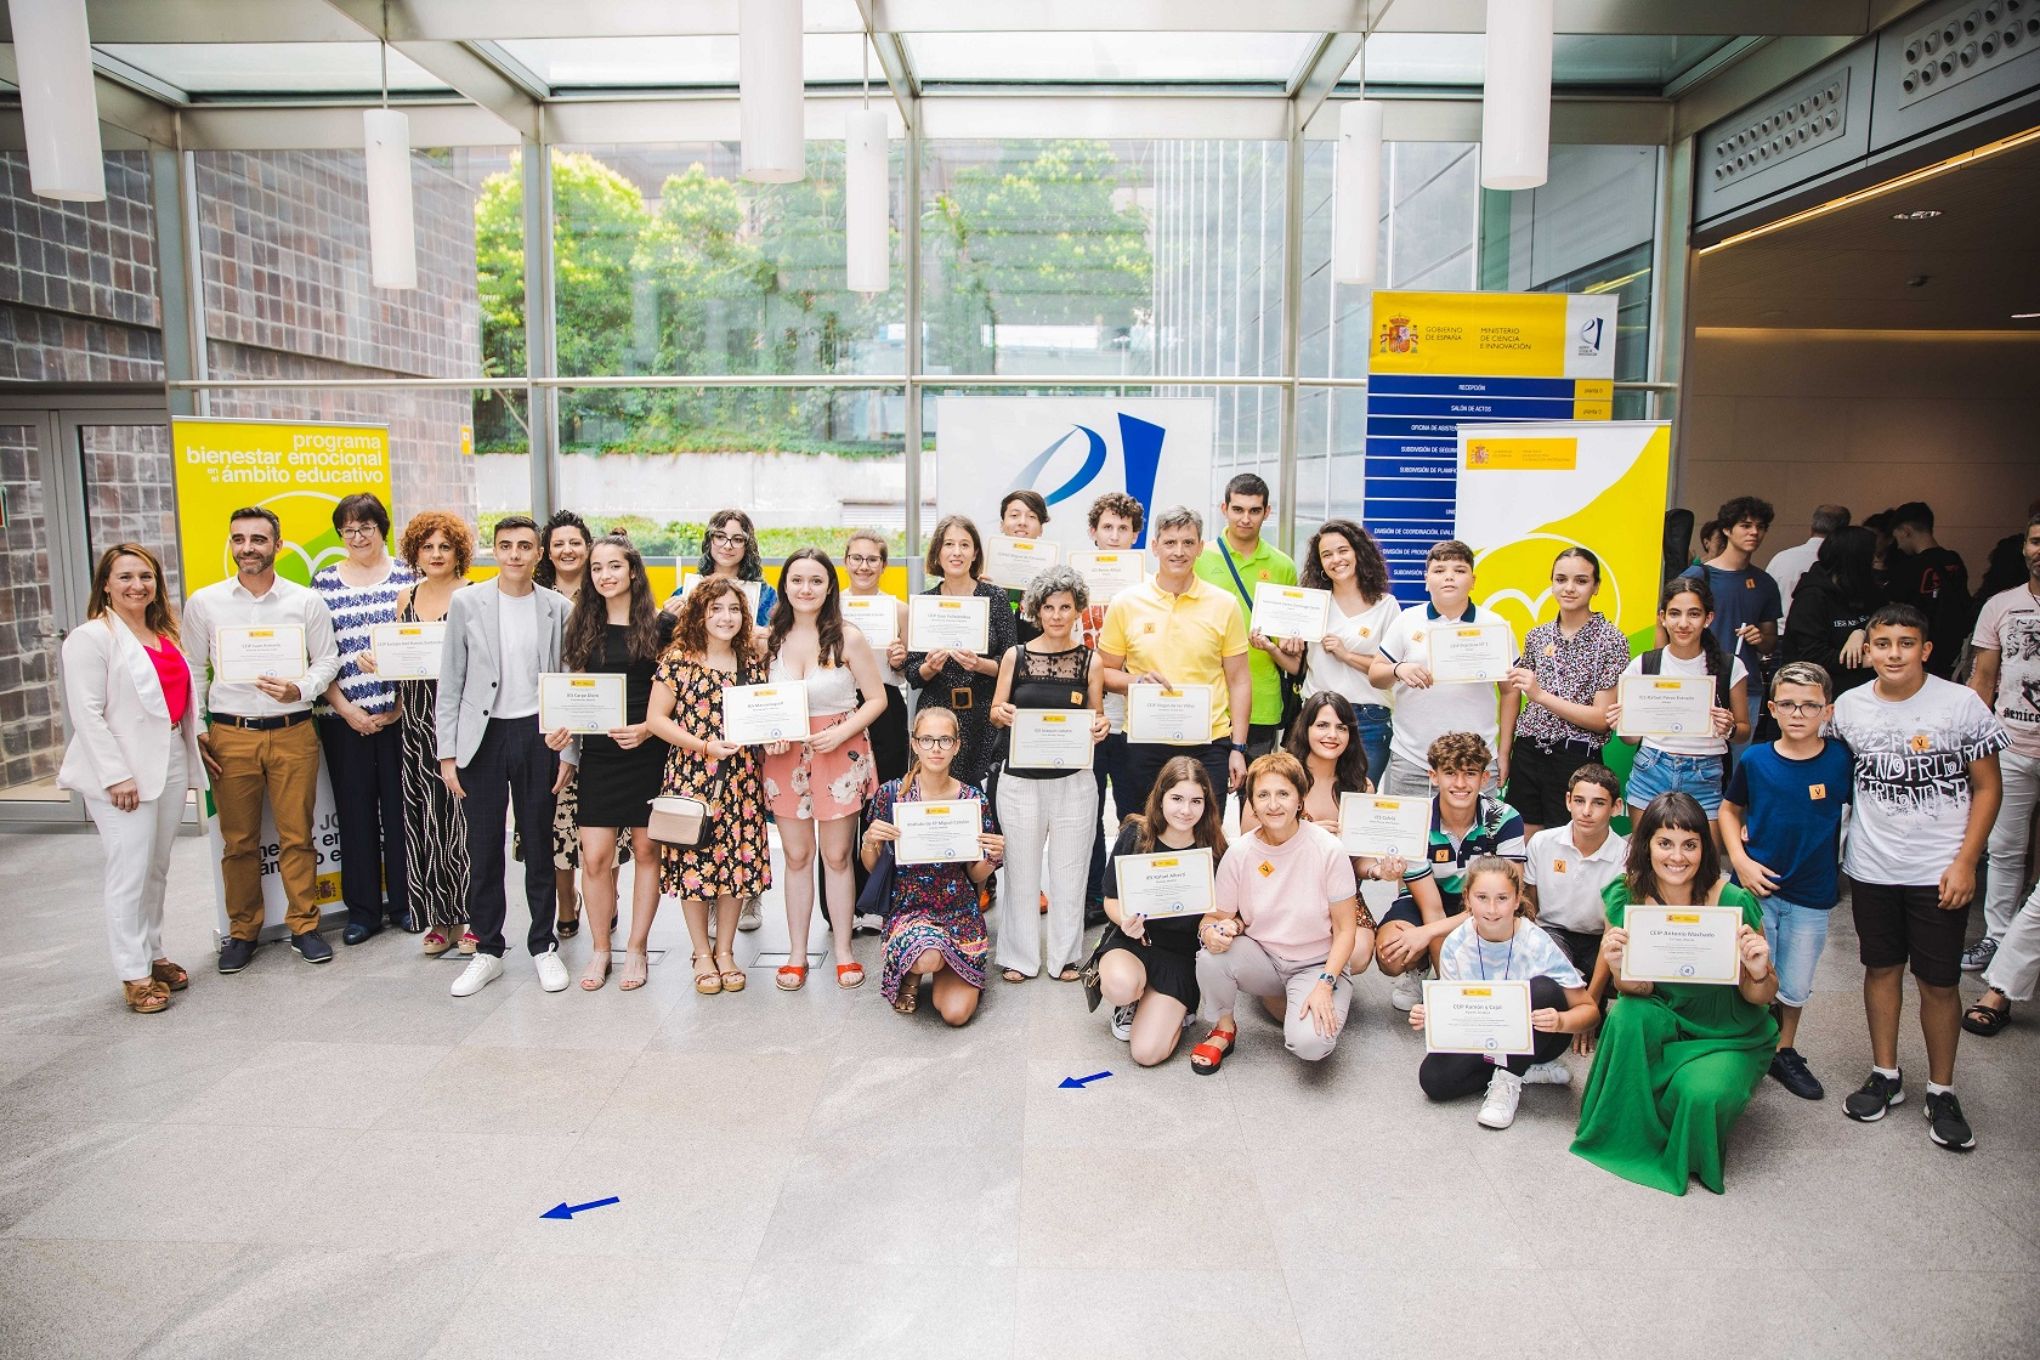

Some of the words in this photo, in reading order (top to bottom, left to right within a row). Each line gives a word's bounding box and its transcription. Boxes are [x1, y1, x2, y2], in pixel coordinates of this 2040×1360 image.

[1426, 326, 1463, 334] GOBIERNO
[1480, 327, 1520, 335] MINISTERIO
[1436, 333, 1462, 341] ESPAÑA
[293, 433, 382, 452] programa
[186, 445, 282, 464] bienestar
[287, 449, 383, 466] emocional
[222, 464, 290, 483] ámbito
[295, 466, 384, 483] educativo
